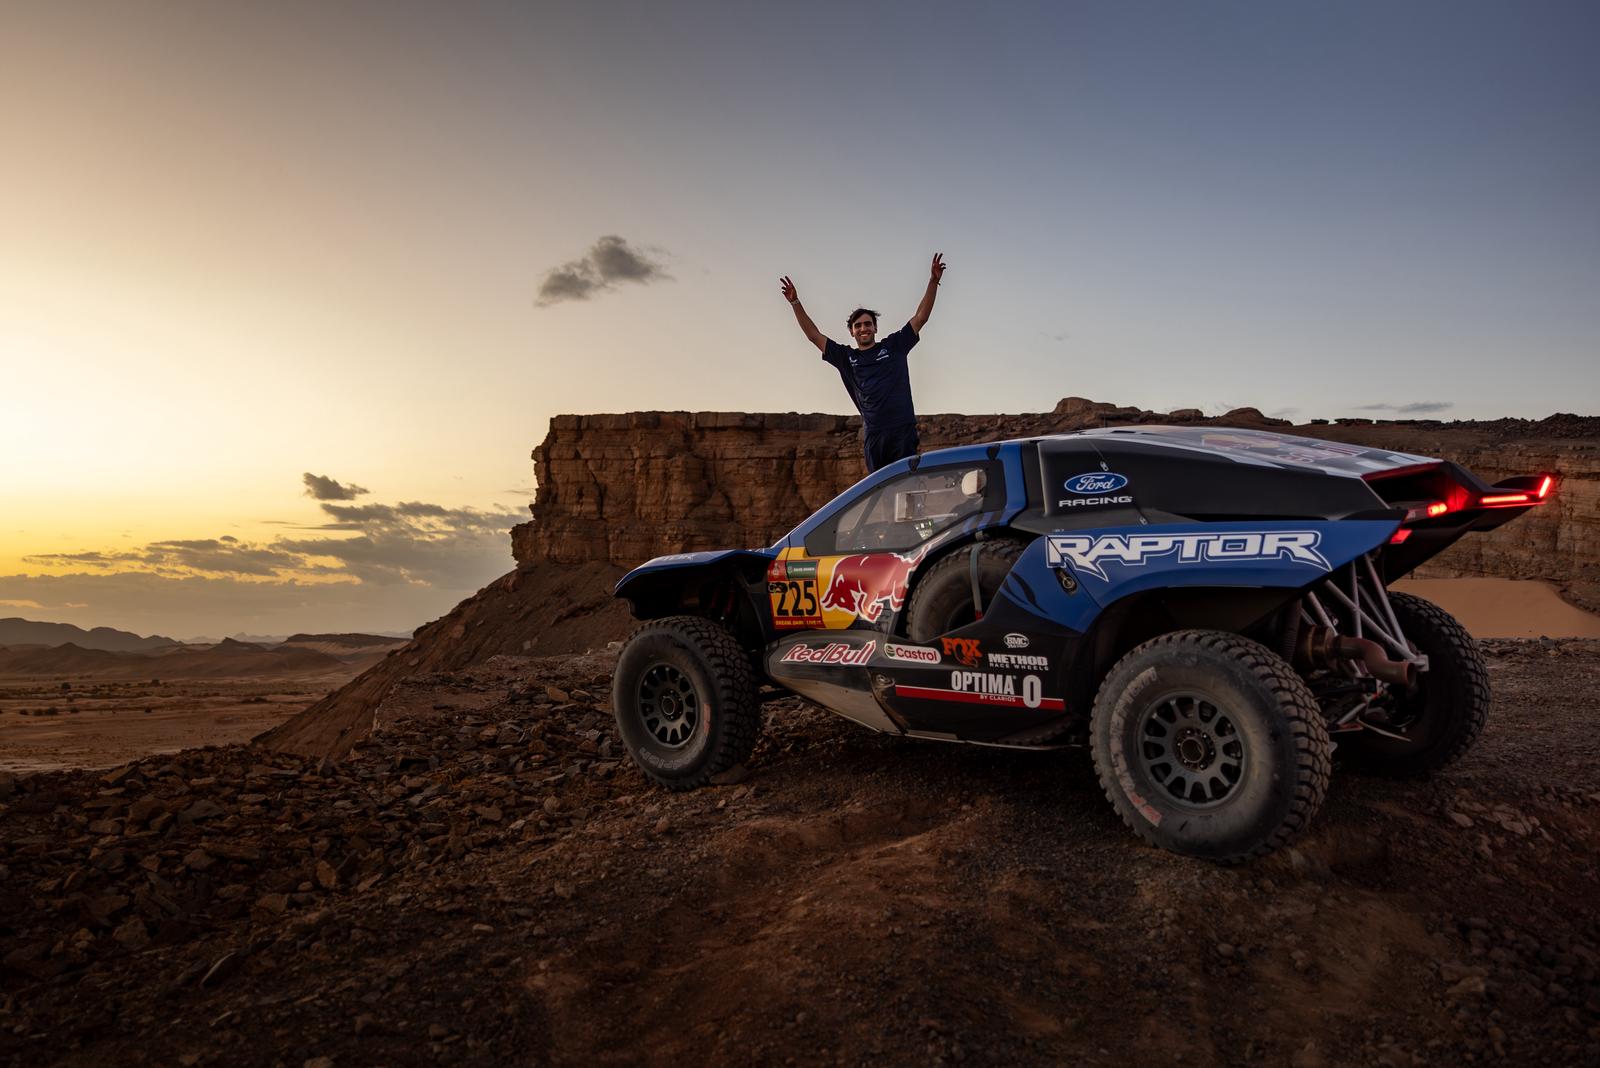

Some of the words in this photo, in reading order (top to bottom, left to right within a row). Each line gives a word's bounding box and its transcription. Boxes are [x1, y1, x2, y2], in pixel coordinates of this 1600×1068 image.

[1076, 475, 1115, 491] Ford
[1058, 496, 1133, 507] RACING
[1047, 531, 1332, 582] RAPTOR
[768, 580, 817, 616] 225
[1006, 637, 1027, 645] BMC
[896, 647, 938, 661] Castrol
[941, 637, 982, 664] FOX
[988, 653, 1048, 667] METHOD
[951, 670, 1015, 695] OPTIMA
